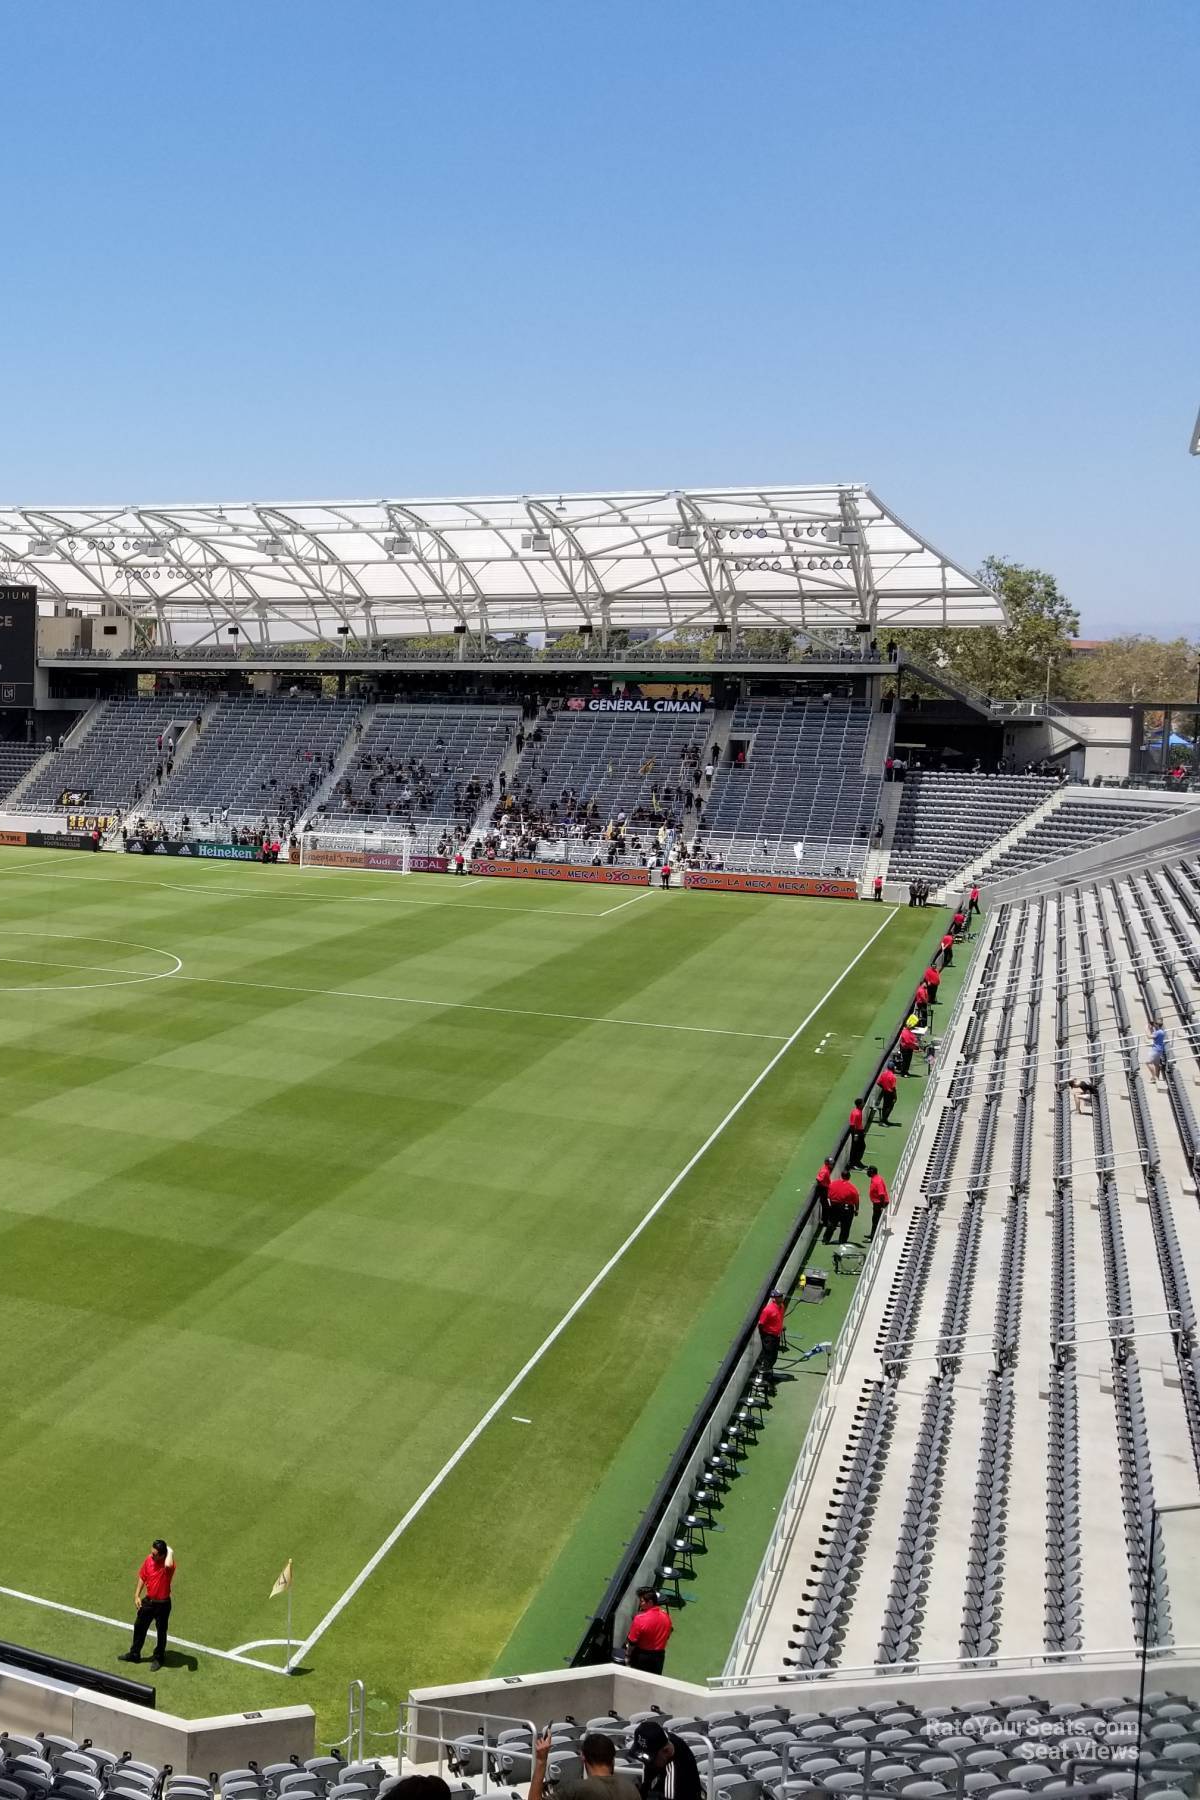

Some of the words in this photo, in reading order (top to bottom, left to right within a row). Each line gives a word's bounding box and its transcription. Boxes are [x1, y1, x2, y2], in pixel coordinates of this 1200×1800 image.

[653, 700, 702, 712] CIMAN
[199, 845, 253, 859] Heineken
[368, 856, 390, 865] Audi
[516, 866, 529, 874] LA
[534, 868, 561, 877] MERA
[567, 871, 600, 879] MERA!
[727, 877, 740, 886] LA
[745, 879, 772, 889] MERA
[778, 881, 809, 891] MERA!
